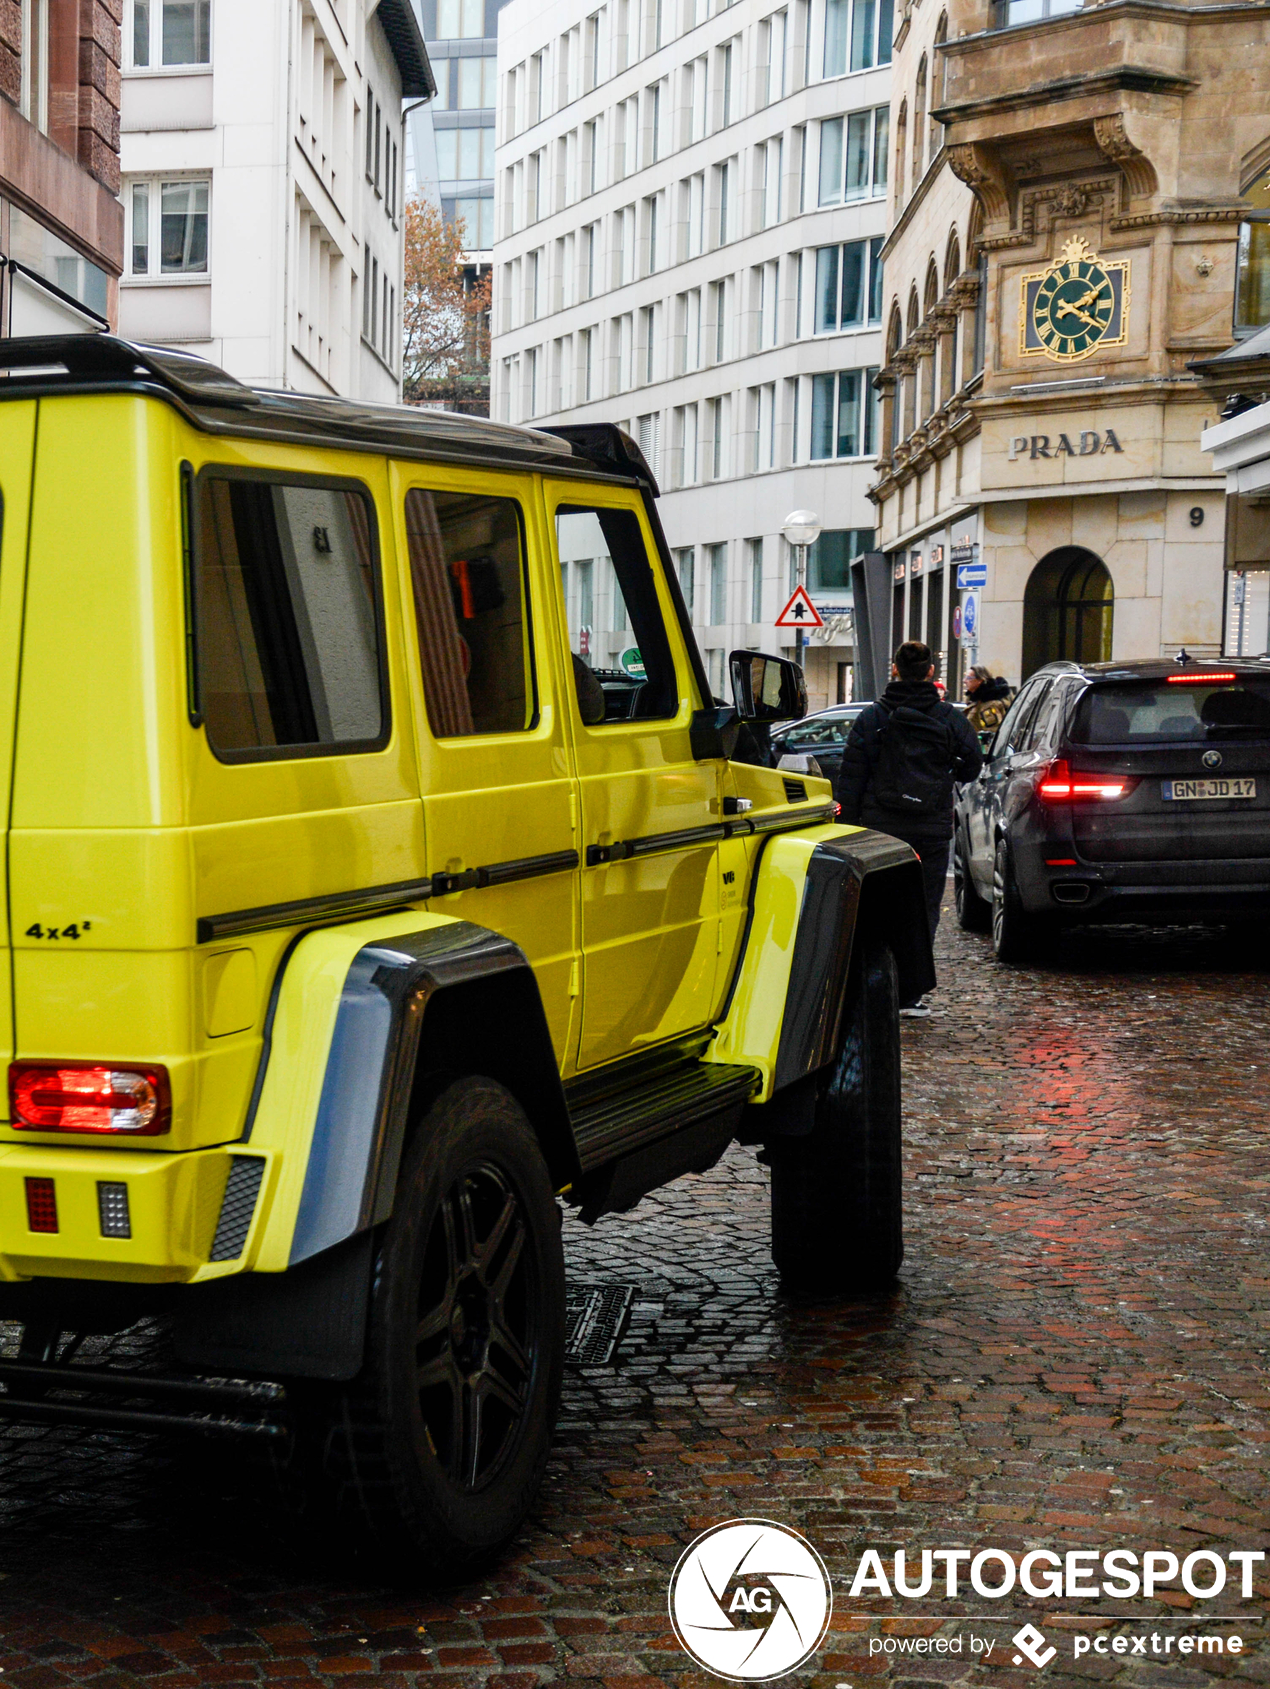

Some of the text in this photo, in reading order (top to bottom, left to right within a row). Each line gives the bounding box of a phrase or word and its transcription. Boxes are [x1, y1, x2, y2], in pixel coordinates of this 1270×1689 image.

[1008, 428, 1125, 461] PRADA
[1189, 506, 1205, 527] 9
[1174, 781, 1254, 797] GN JD 17
